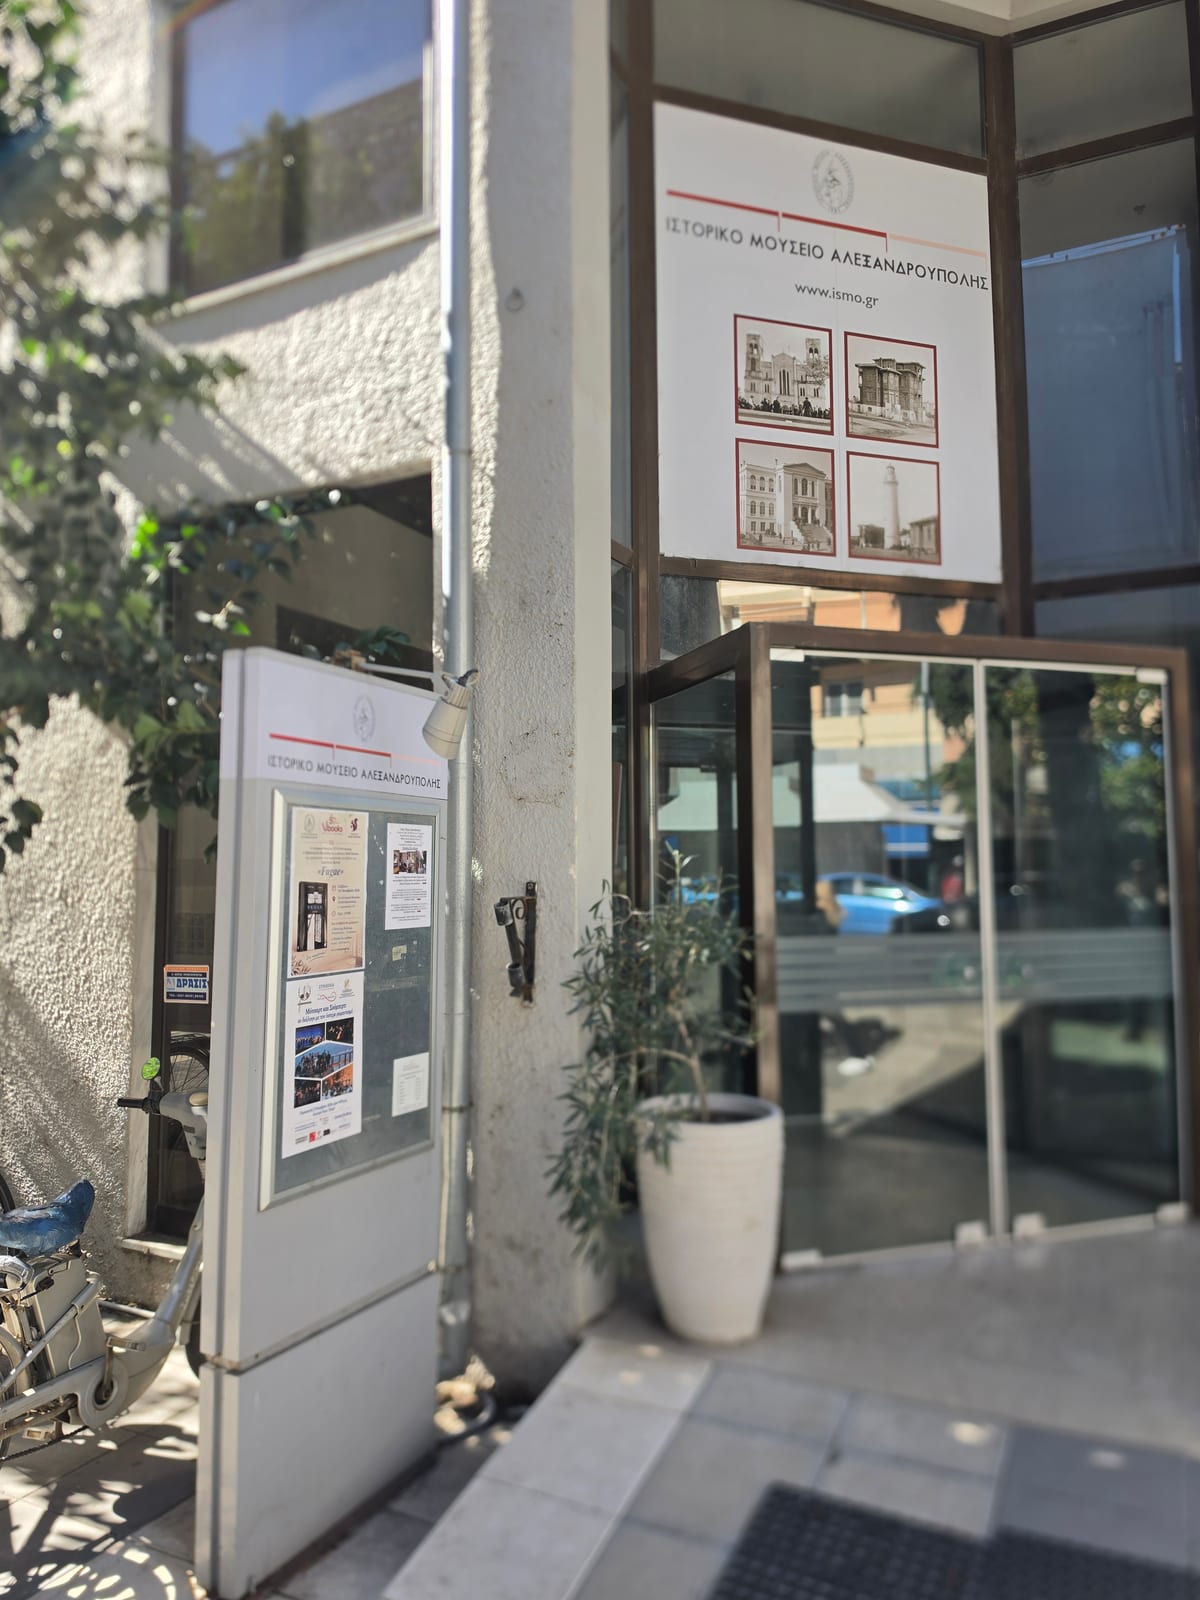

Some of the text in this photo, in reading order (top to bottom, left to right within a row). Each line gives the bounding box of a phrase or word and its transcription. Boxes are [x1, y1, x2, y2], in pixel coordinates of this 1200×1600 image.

[665, 216, 989, 290] ΙΣΤΟΡΙΚΟ ΜΟΥΣΕΙΟ ΑΛΕΞΑΝΔΡΟΥΠΟΛΗΣ
[795, 283, 879, 309] www.ismo.gr
[267, 754, 442, 789] ΙΣΤΟΡΙΚΟ ΜΟΥΣΕΙΟ ΑΛΕΞΑΝΔΡΟΥΠΟΛΗΣ
[177, 978, 207, 989] ΔΡΑΣΙΣ
